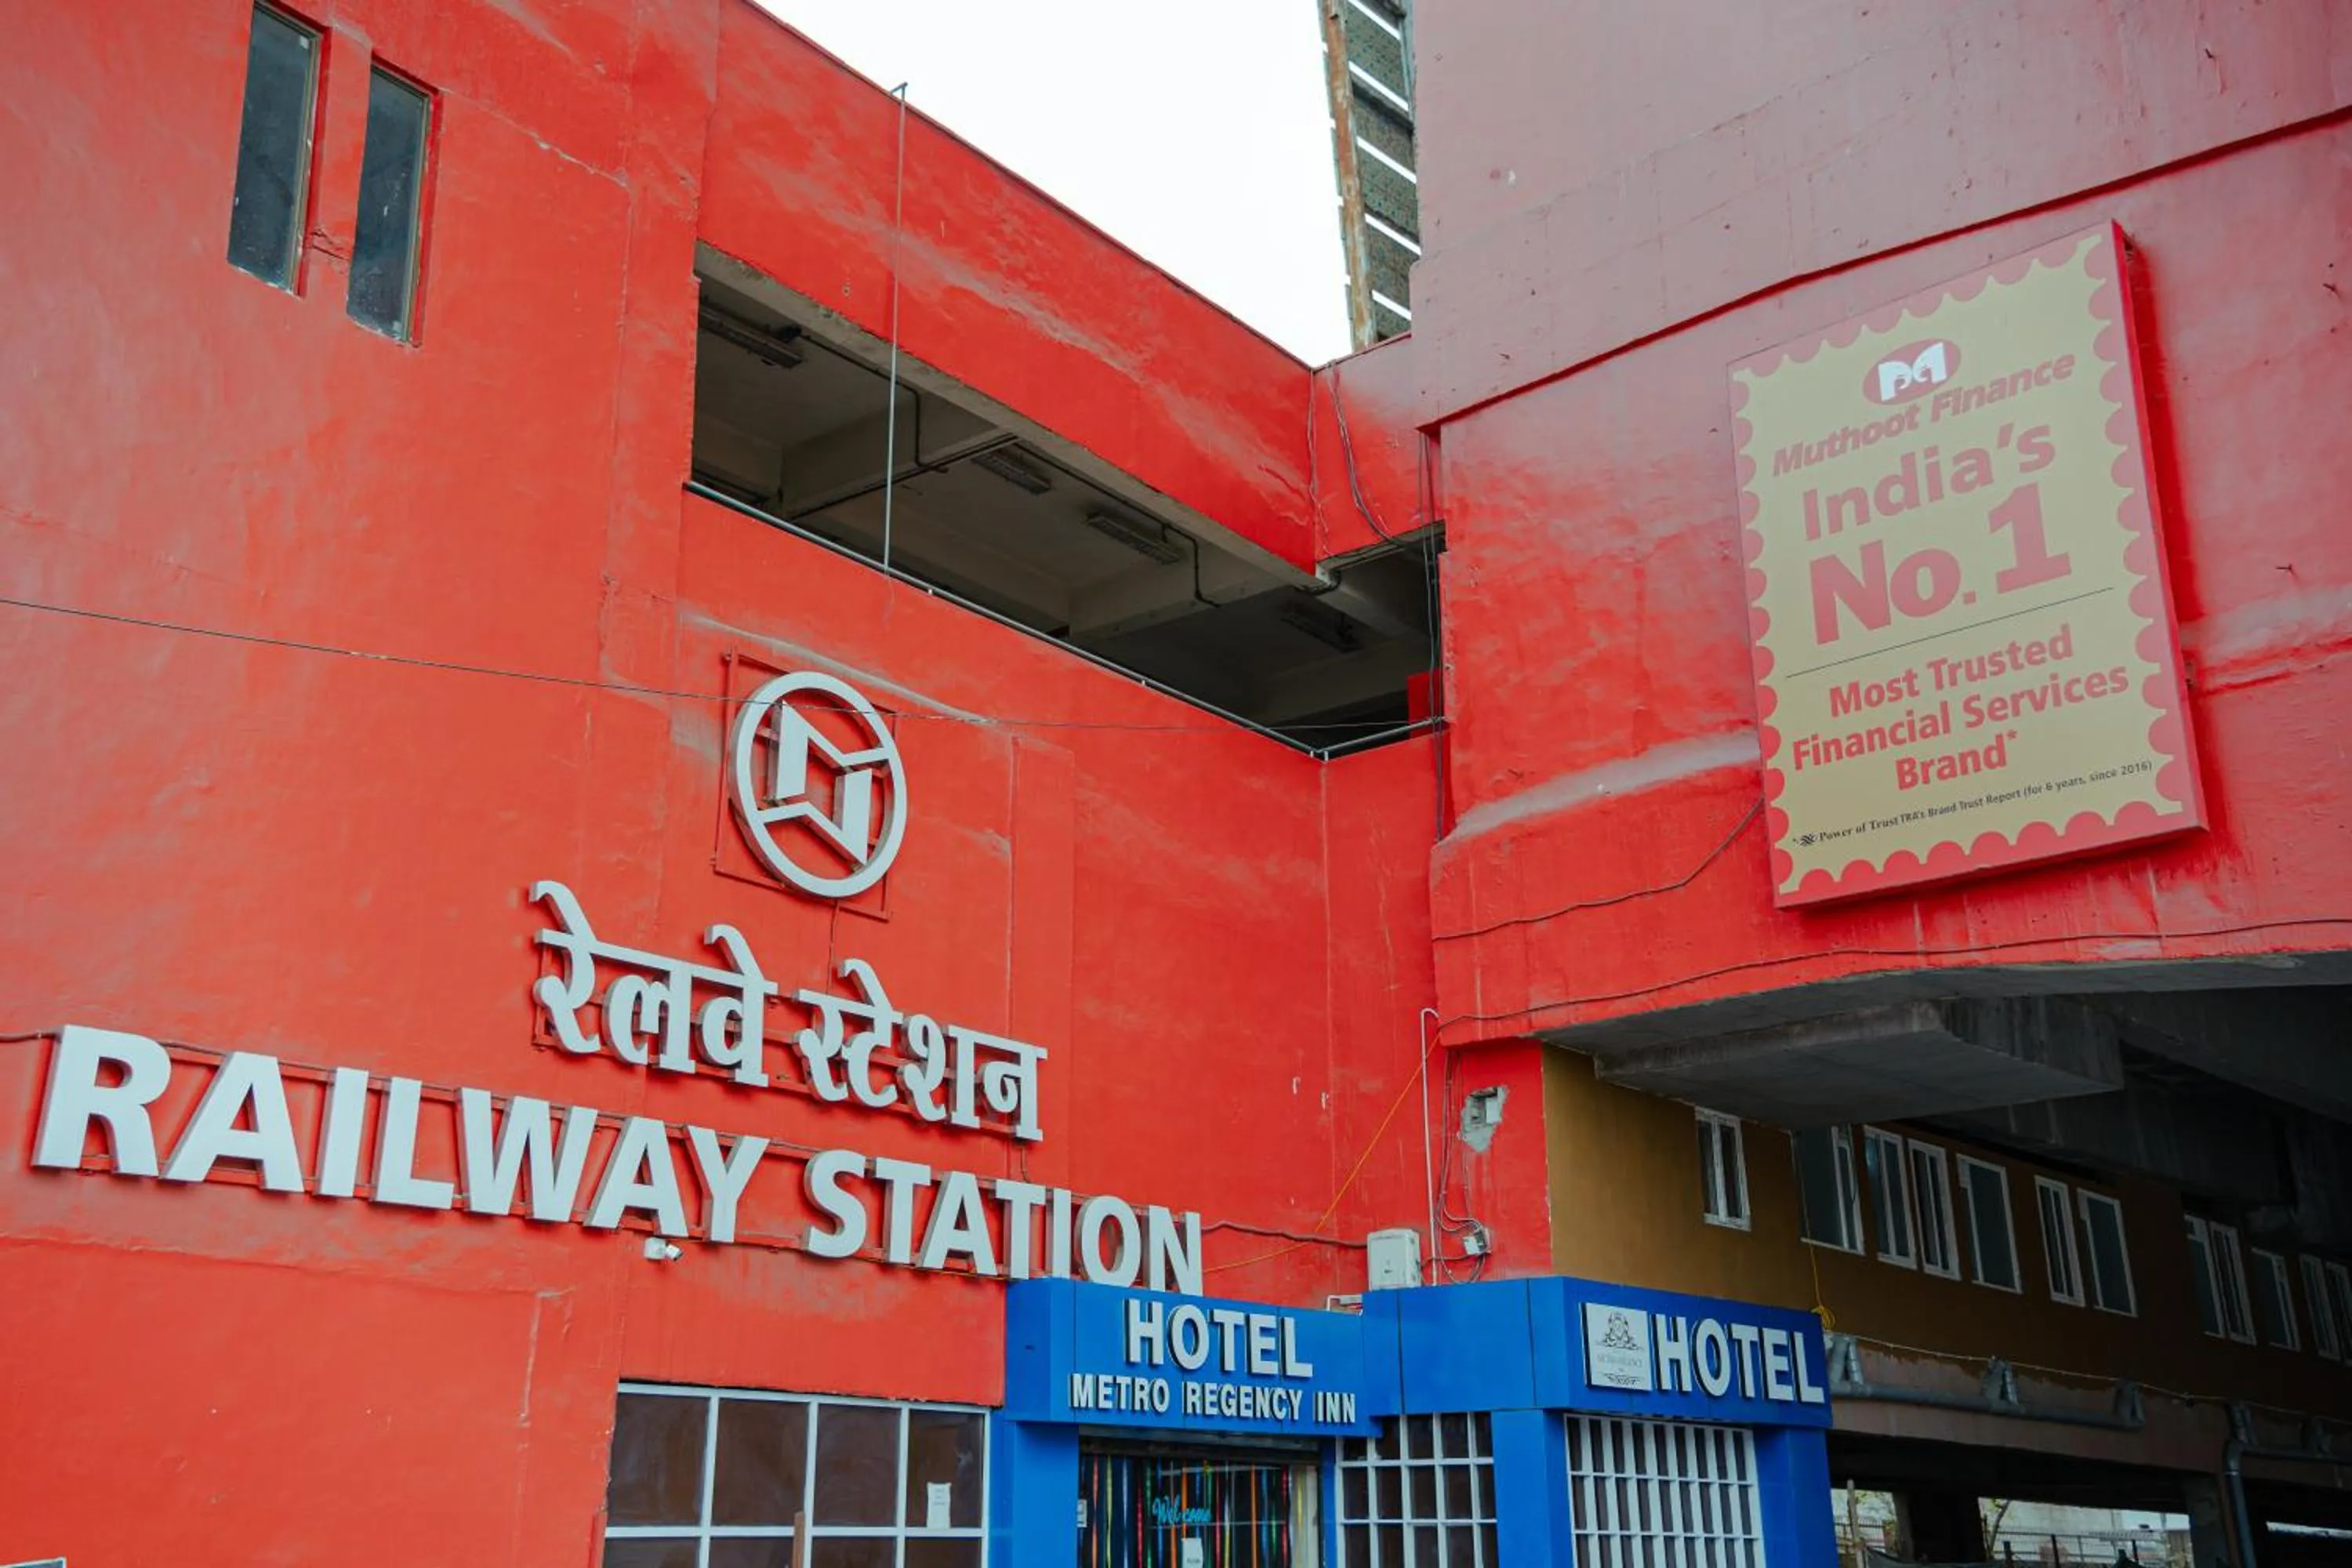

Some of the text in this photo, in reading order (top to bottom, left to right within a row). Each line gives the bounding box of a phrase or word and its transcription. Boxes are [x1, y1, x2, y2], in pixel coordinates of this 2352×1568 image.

[1773, 354, 2075, 477] Muthoot Finance
[1803, 423, 2056, 541] India's
[1792, 666, 2129, 771] Financial Services
[1829, 623, 2074, 717] Most Trusted
[1819, 828, 1853, 842] Power
[1856, 822, 1866, 833] of
[1869, 815, 1898, 830] Trust
[1928, 803, 1957, 817] Brand
[1959, 797, 1983, 811] Trust
[1986, 789, 2021, 804] Report
[2024, 784, 2042, 798] (for
[2089, 768, 2118, 782] since
[2121, 760, 2153, 776] 2016)
[529, 880, 1047, 1142] रेलवे स्टेशन
[31, 1024, 1203, 1296] RAILWAY STATION
[1124, 1298, 1313, 1378] HOTEL
[1651, 1313, 1825, 1404] HOTEL
[1070, 1373, 1356, 1424] METRO REGENCY INN
